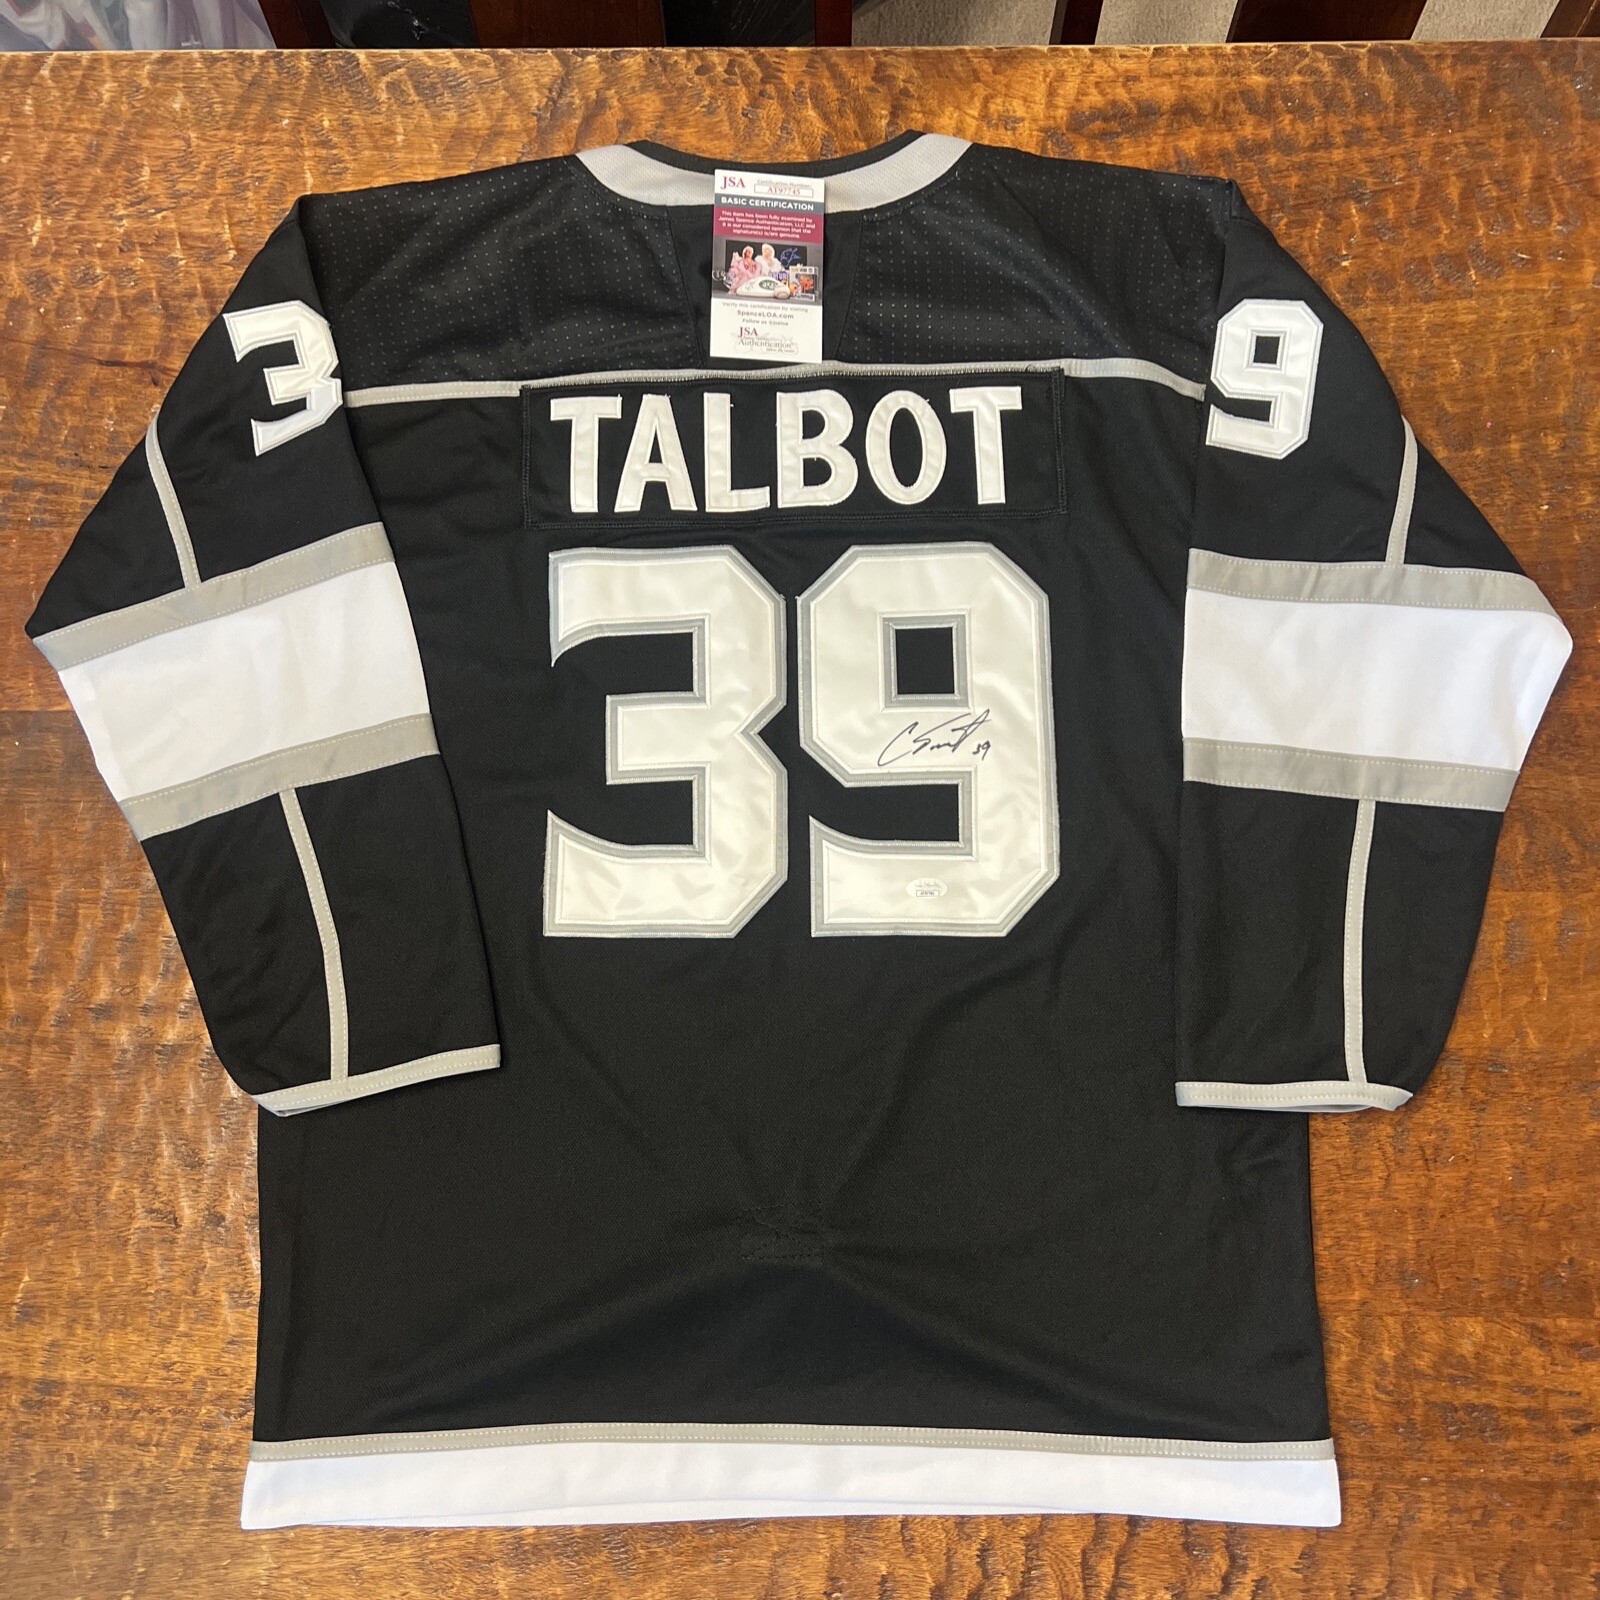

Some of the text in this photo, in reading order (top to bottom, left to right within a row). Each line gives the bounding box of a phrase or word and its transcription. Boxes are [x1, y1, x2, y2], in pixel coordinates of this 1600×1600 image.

[720, 176, 746, 190] JSA
[721, 196, 814, 211] BASIC CERTIFICATION
[737, 309, 795, 320] SpenceLOA.com
[737, 326, 759, 338] JSA
[222, 300, 343, 457] 3
[1206, 298, 1324, 460] 9
[550, 386, 1022, 513] TALBOT
[543, 541, 1061, 938] 39
